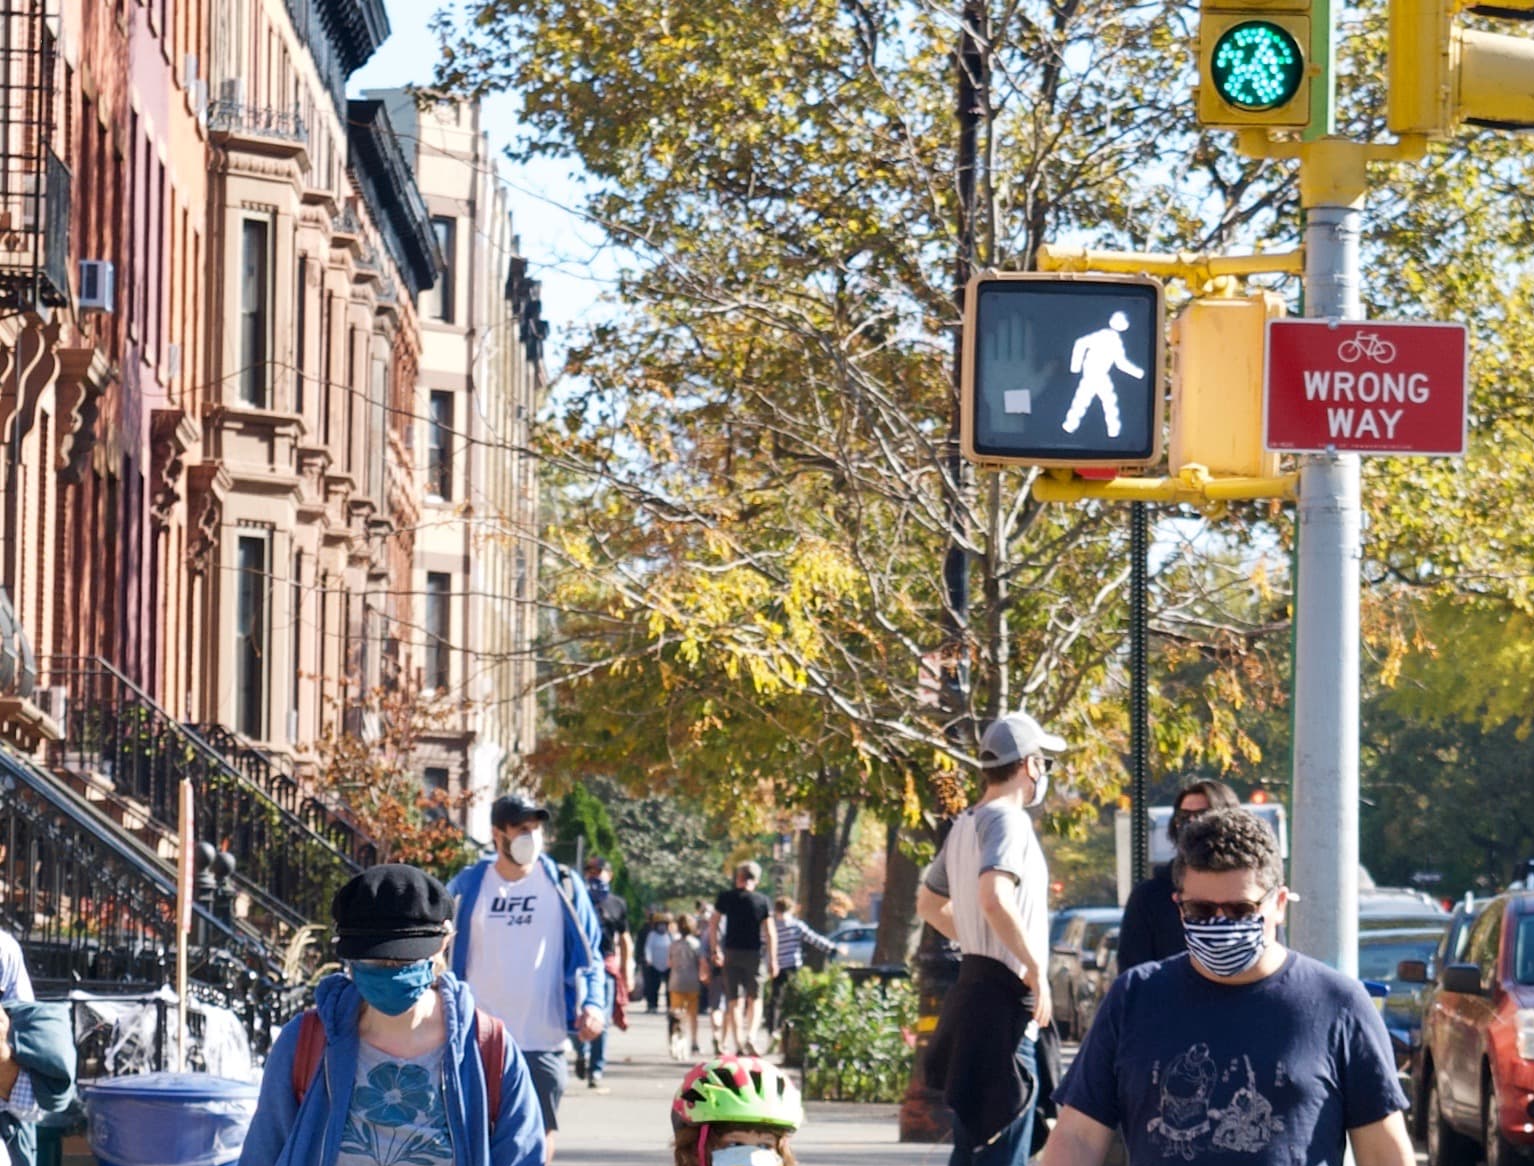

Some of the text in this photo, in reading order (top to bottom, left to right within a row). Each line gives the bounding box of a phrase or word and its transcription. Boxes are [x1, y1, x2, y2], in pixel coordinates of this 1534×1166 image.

[1304, 370, 1429, 403] WRONG
[1327, 408, 1402, 439] WAY
[490, 896, 536, 912] UFC
[507, 914, 532, 926] 244
